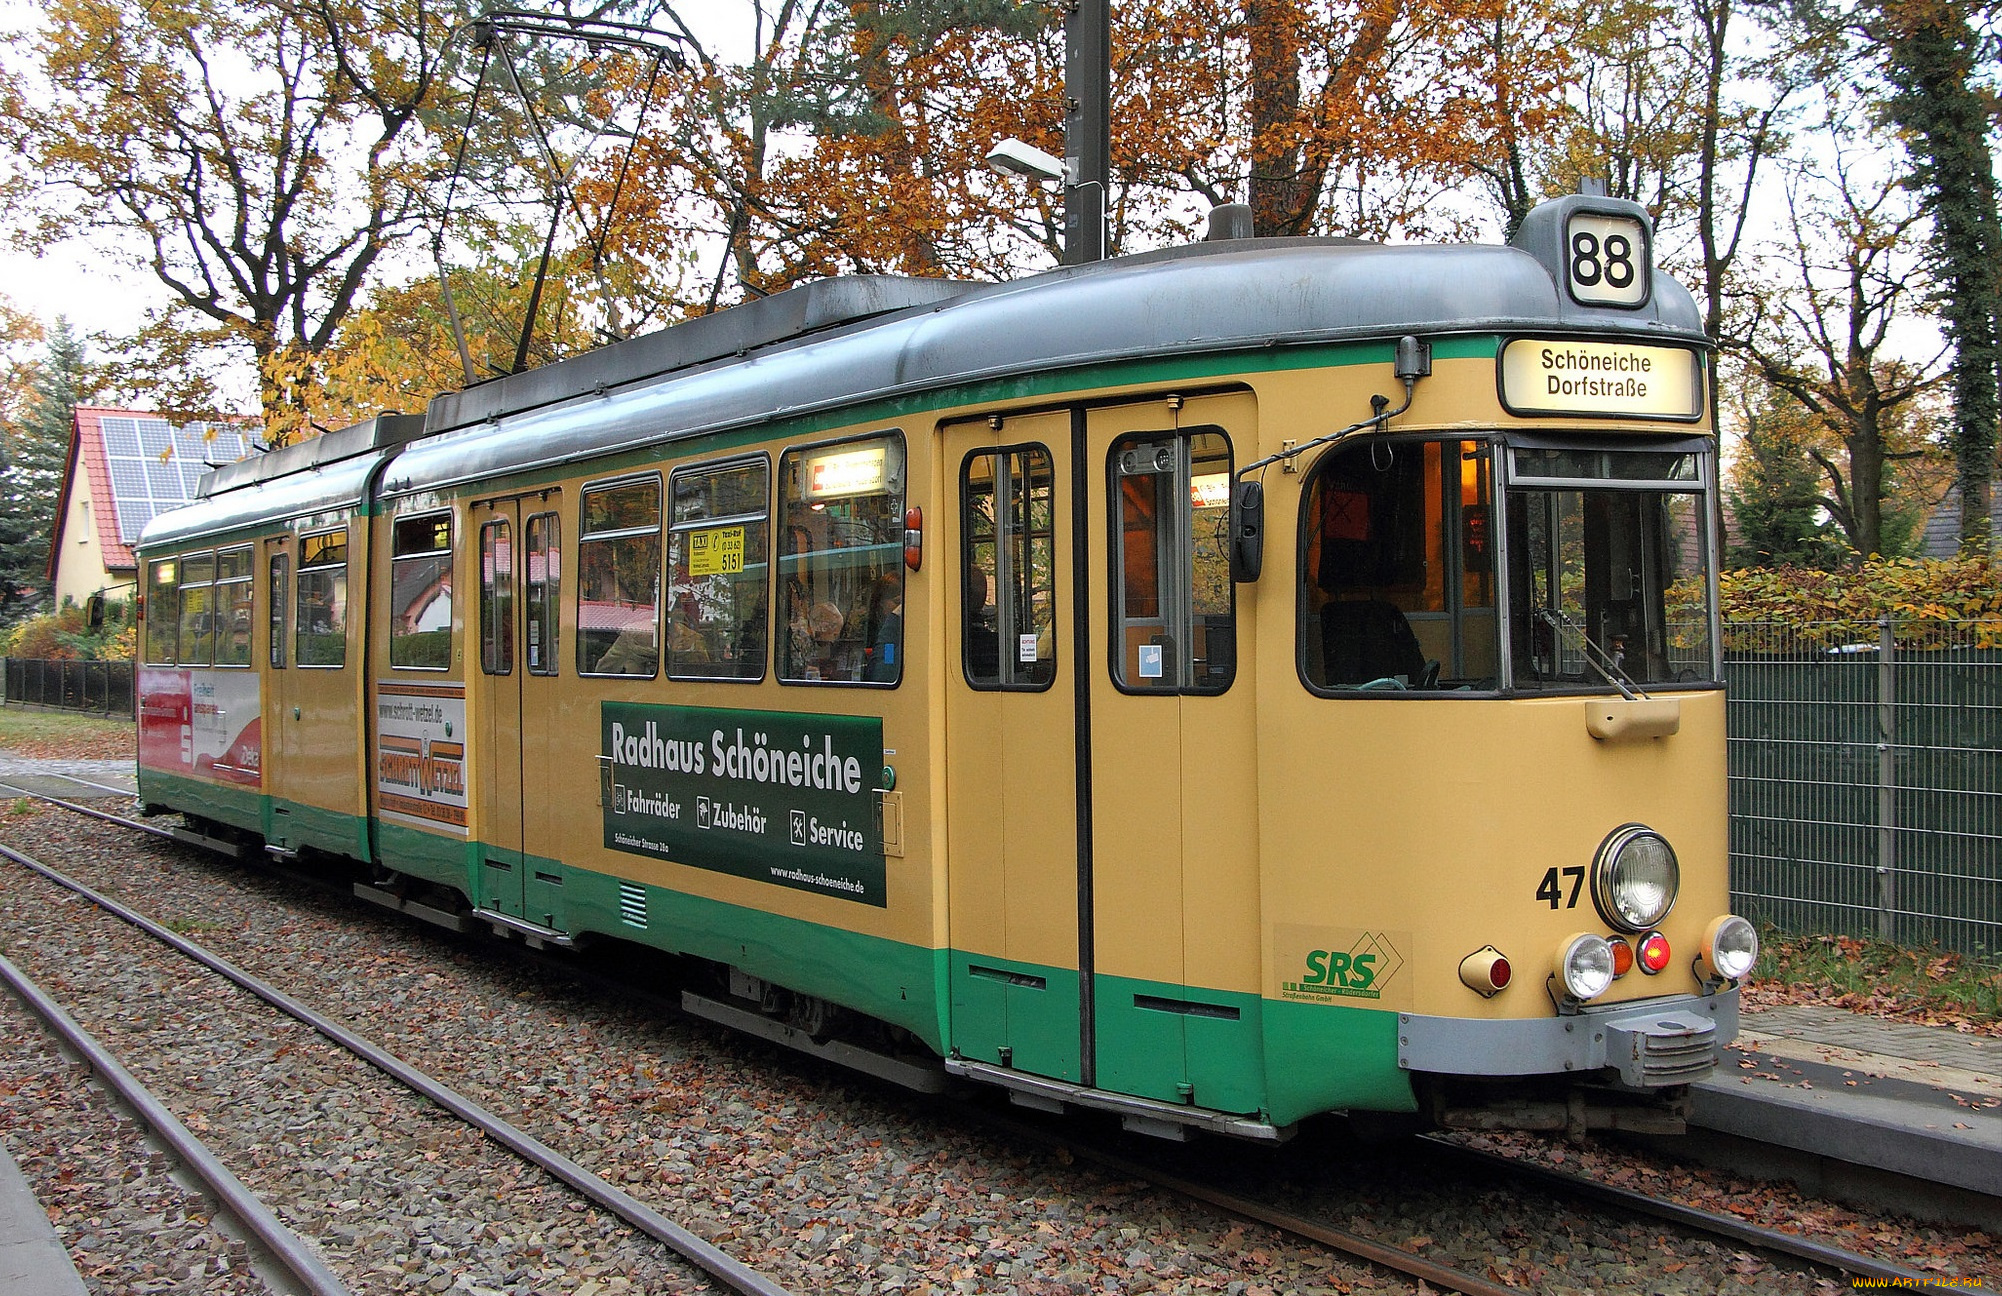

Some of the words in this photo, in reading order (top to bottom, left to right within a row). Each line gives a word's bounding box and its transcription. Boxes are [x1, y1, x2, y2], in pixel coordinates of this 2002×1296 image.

[1572, 231, 1635, 289] 88
[1541, 348, 1651, 372] Schöneiche
[1548, 375, 1648, 398] Dorfstraße
[693, 536, 707, 548] TAXI
[722, 529, 742, 539] Taxi-Ruf
[722, 553, 741, 571] 5151
[612, 721, 705, 775] Radhaus
[711, 727, 862, 794] Schöneiche
[627, 789, 681, 819] Fahrräder
[713, 802, 767, 834] Zubehör
[614, 832, 641, 848] Schöneicher
[641, 838, 659, 851] Strasse
[809, 816, 864, 851] Service
[770, 866, 865, 894] www.radhaus-schoeneiche.de
[1536, 866, 1585, 910] 47
[1303, 949, 1377, 990] SRS
[1303, 984, 1337, 994] Schöneicher
[1341, 988, 1380, 998] Rüdersdorfer
